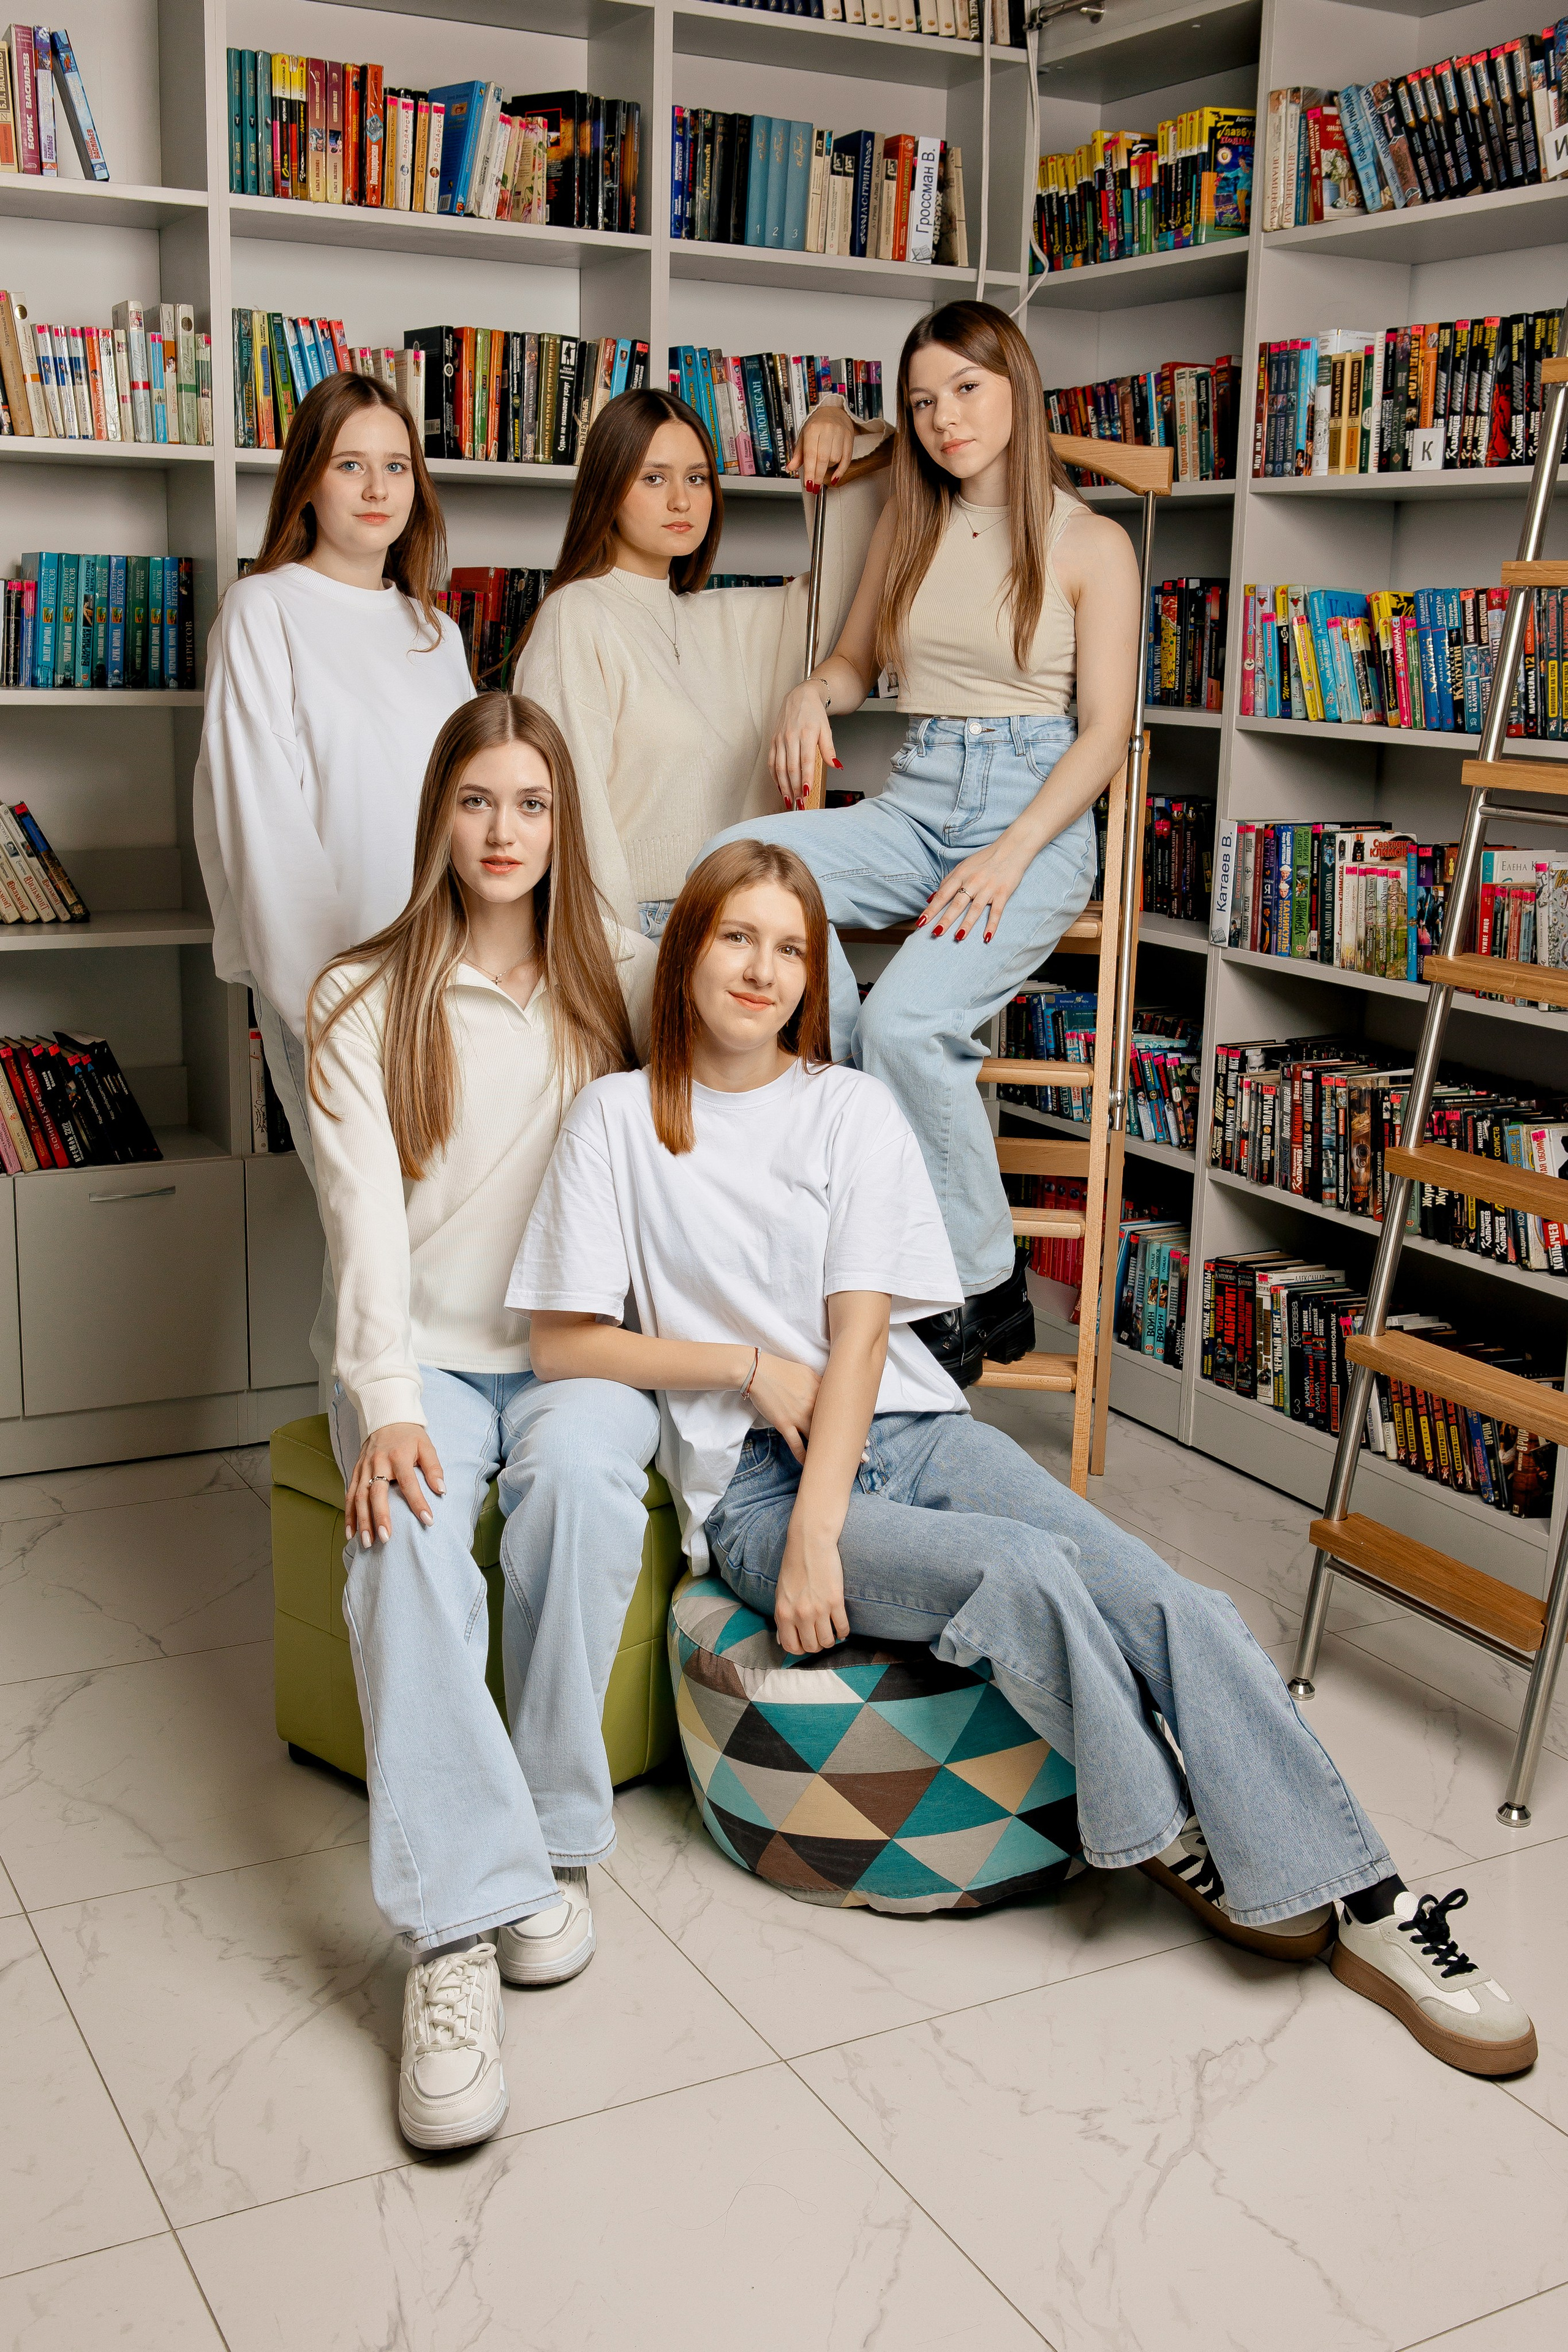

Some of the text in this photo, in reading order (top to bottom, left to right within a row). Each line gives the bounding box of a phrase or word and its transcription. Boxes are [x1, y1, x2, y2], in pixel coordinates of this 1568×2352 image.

[23, 53, 32, 108] ВАСИЛЬЕВ
[86, 129, 100, 159] ВАСИЛЬЕВ
[916, 149, 935, 233] Гроссман В.
[1270, 156, 1279, 227] ЗНАМЕНСКАЯ
[1284, 153, 1295, 223] ЗНАМЕНСКАЯ
[756, 225, 760, 233] 1
[772, 227, 778, 236] 2
[792, 229, 797, 238] 3
[546, 337, 557, 392] СТРУГАЦКИХ
[545, 393, 554, 430] БРАТЬЕВ
[753, 380, 772, 450] ЦИКЛОГЕКСАН
[1255, 442, 1261, 451] на
[1422, 440, 1433, 461] К
[1446, 415, 1460, 459] КАЗАНЦЕВ
[1472, 417, 1488, 460] КАЗАНЦЕВ
[1511, 415, 1523, 459] КАЗАНЦЕВ
[1177, 626, 1181, 635] ДО
[1393, 627, 1404, 663] КАЛИНИНА
[1423, 638, 1437, 693] КАЛУГИН
[1453, 646, 1463, 700] КАЛУГИН
[1526, 657, 1535, 669] 12
[1216, 831, 1232, 913] Катаев В.
[1295, 900, 1305, 935] УБОЙНЫЙ
[25, 1063, 49, 1113] КРЕАТИВА
[1225, 1109, 1235, 1140] КОЛЫЧЕВ
[1281, 1087, 1291, 1139] Прости, прощай
[1262, 1135, 1272, 1160] КОЛЫЧЕВ
[1323, 1150, 1333, 1178] ВОР
[1292, 1148, 1302, 1189] КОЛЫЧЕВ
[1481, 1210, 1491, 1249] КОЛЫЧЕВ
[1548, 1223, 1564, 1269] КОЛЫЧЕВ
[1215, 1295, 1224, 1332] ЧЕРНЫЙ
[1224, 1286, 1236, 1345] ЛАБИРИНТ
[1291, 1301, 1301, 1348] Коптяева
[1272, 1335, 1282, 1372] ЧЕРНЫЙ
[1316, 1360, 1327, 1412] КОРЕЦКИЙ
[1422, 1420, 1431, 1457] ПАНТЕРА
[1483, 1422, 1491, 1440] РОТА
